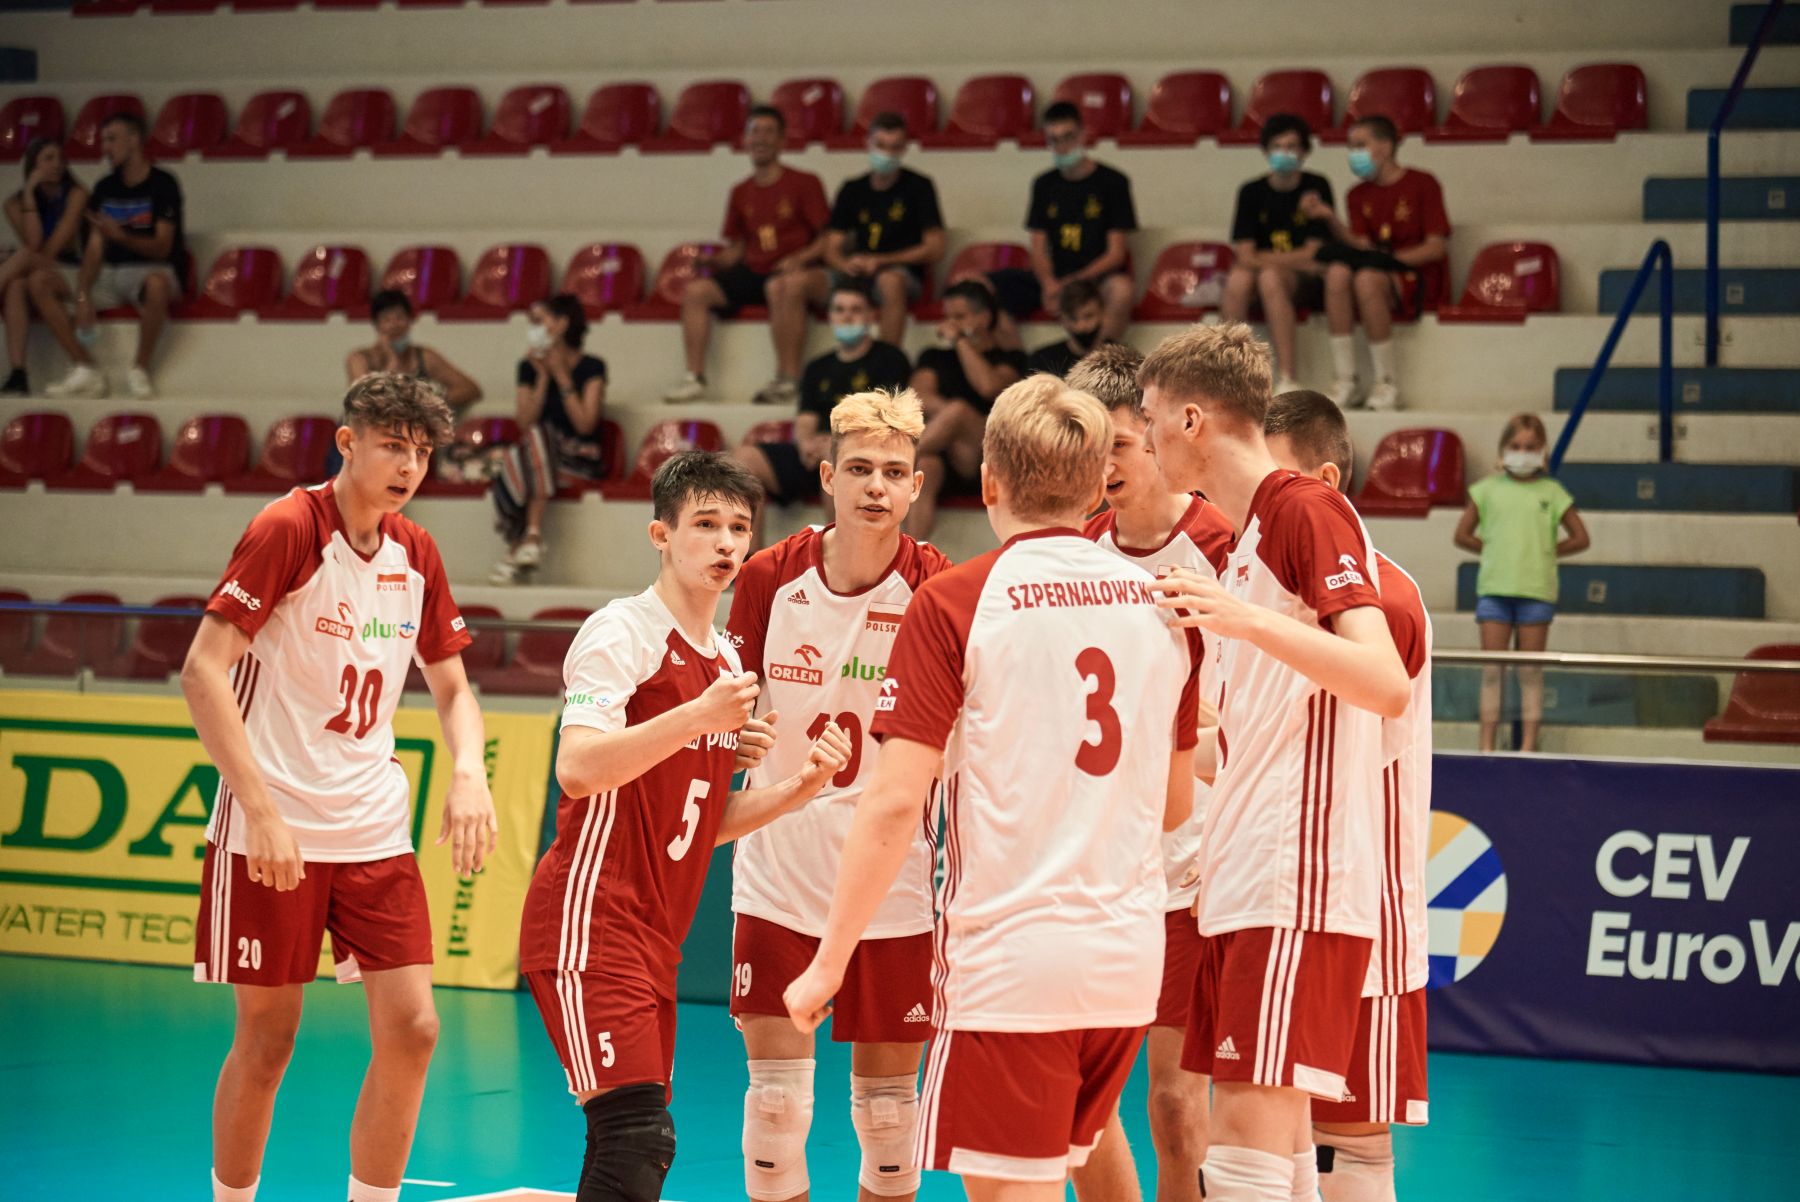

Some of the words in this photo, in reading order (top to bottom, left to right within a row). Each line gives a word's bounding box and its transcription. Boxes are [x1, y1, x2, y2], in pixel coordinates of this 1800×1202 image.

[361, 617, 397, 642] plus
[865, 622, 897, 633] POLSK
[770, 665, 820, 684] ORLEN
[324, 663, 383, 740] 20
[1074, 646, 1122, 777] 3
[1, 754, 220, 858] DA
[667, 778, 710, 861] 5
[1595, 830, 1751, 901] CEV
[117, 911, 193, 944] TEC
[237, 936, 262, 970] 20
[1585, 911, 1800, 986] EuroV
[734, 962, 752, 997] 19
[597, 1031, 616, 1068] 5
